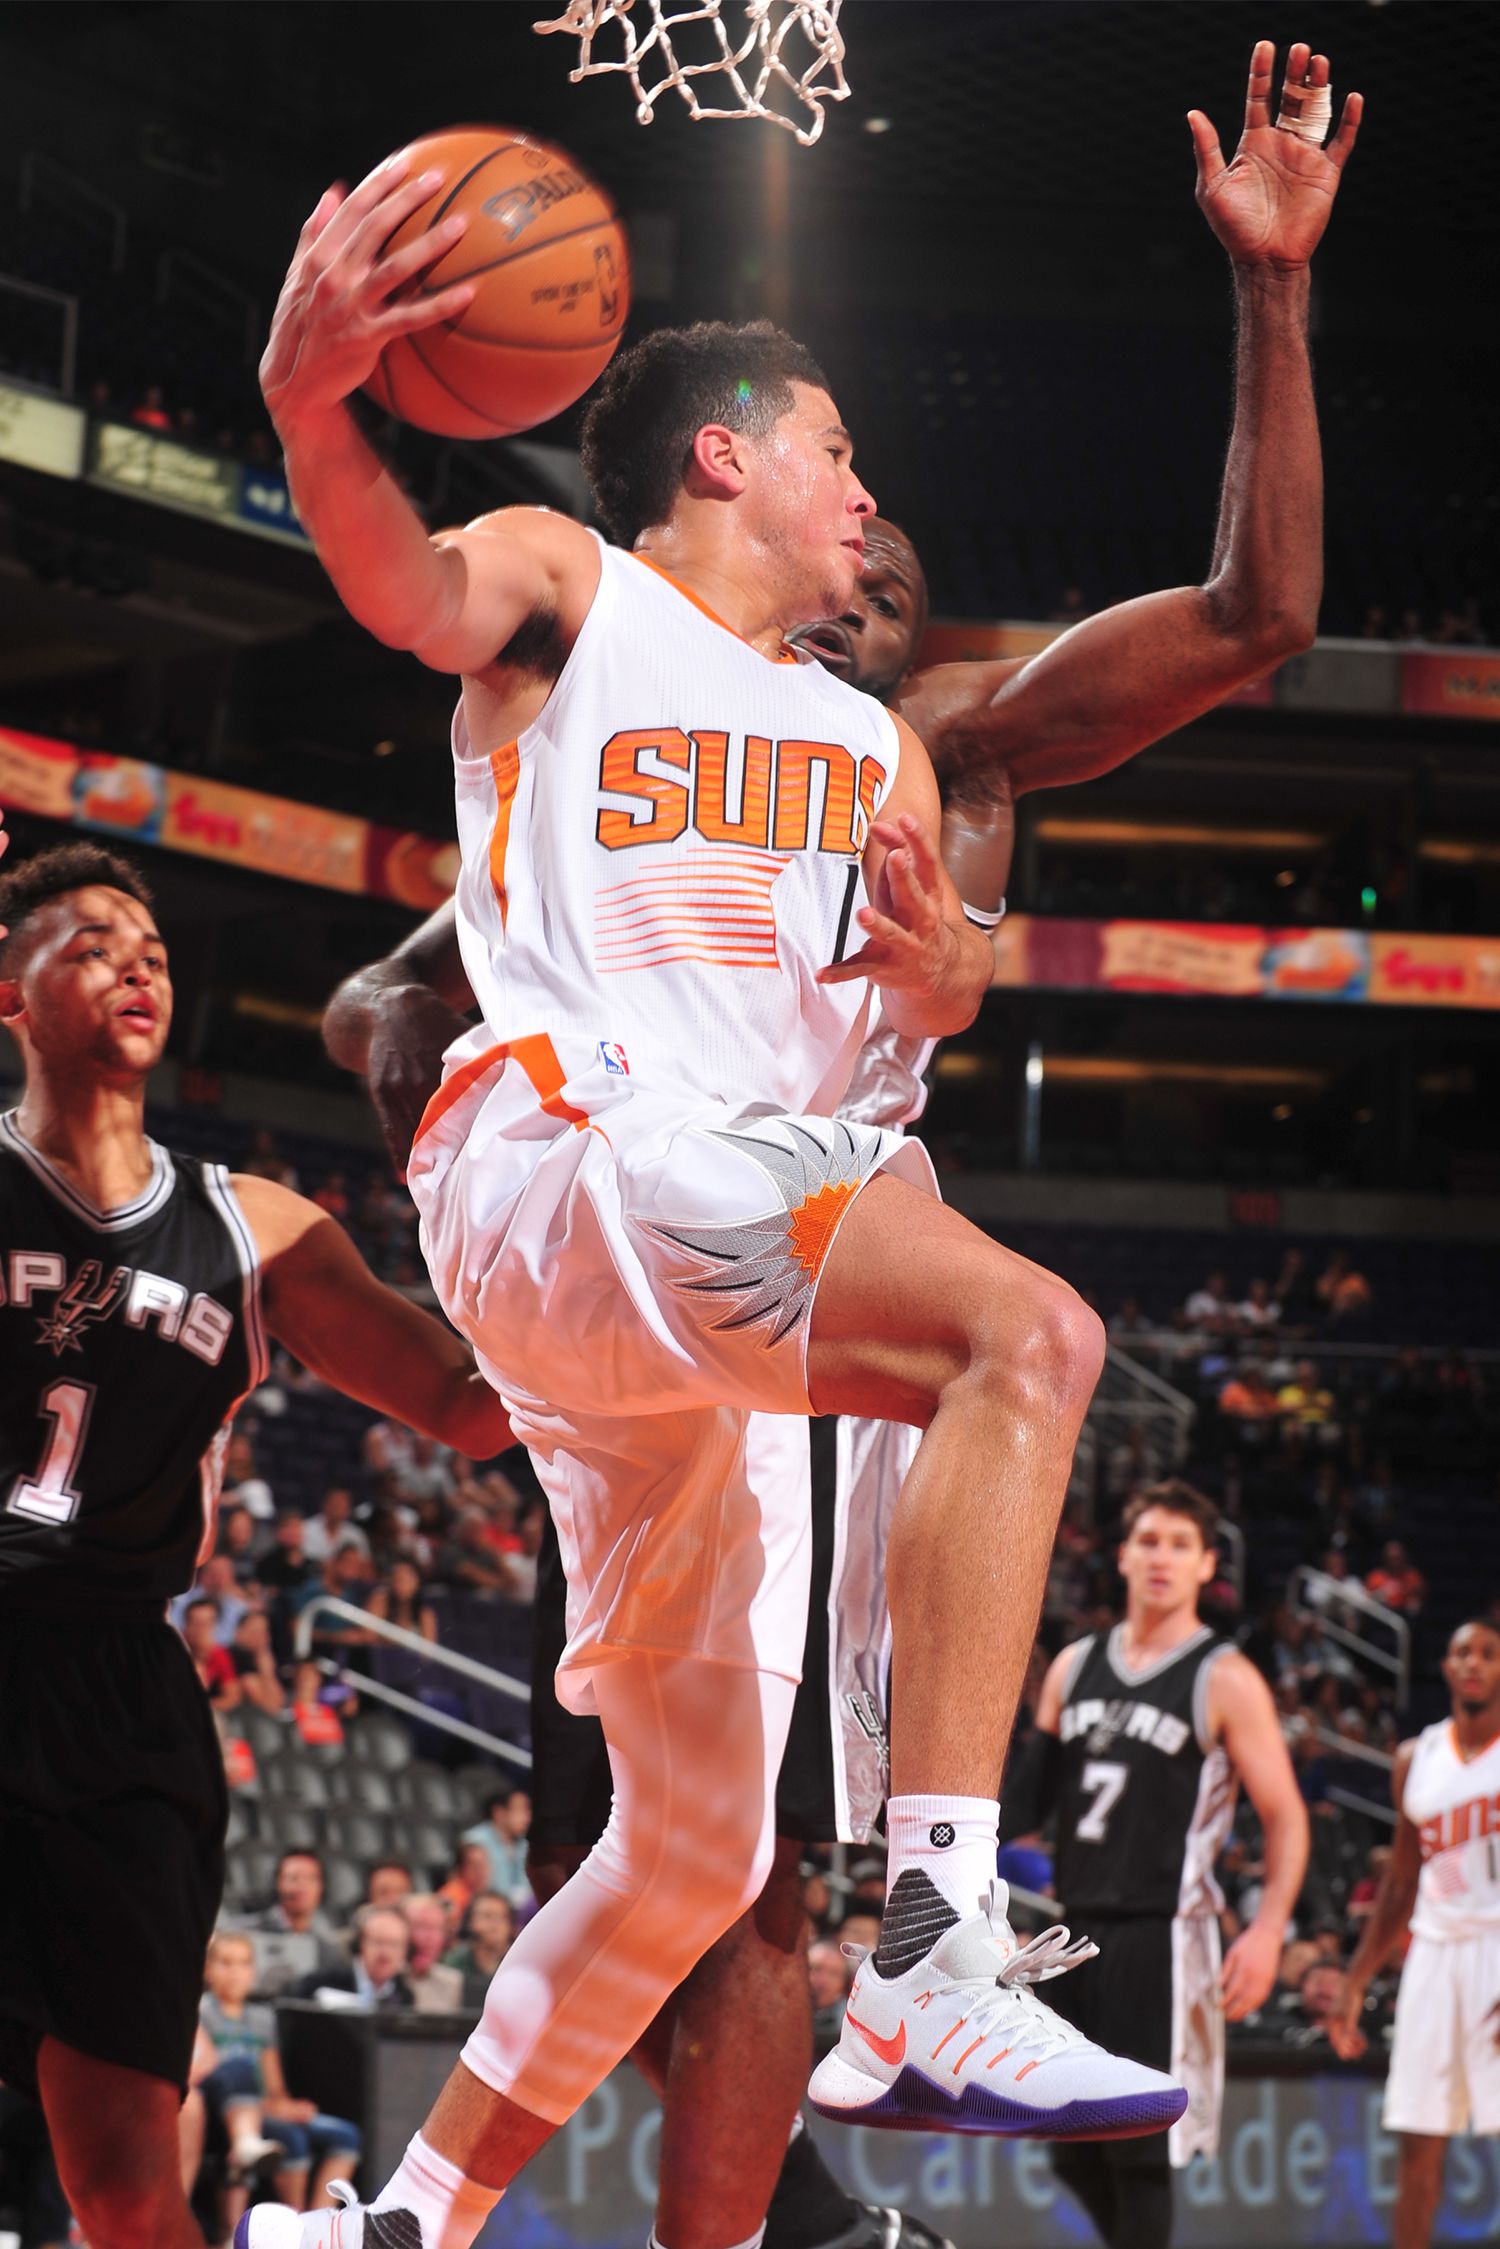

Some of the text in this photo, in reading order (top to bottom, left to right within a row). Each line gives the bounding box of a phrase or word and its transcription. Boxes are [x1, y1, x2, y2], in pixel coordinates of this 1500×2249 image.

[0, 1249, 234, 1367] PURS
[6, 1376, 97, 1527] 1
[1075, 1761, 1127, 1842] 7
